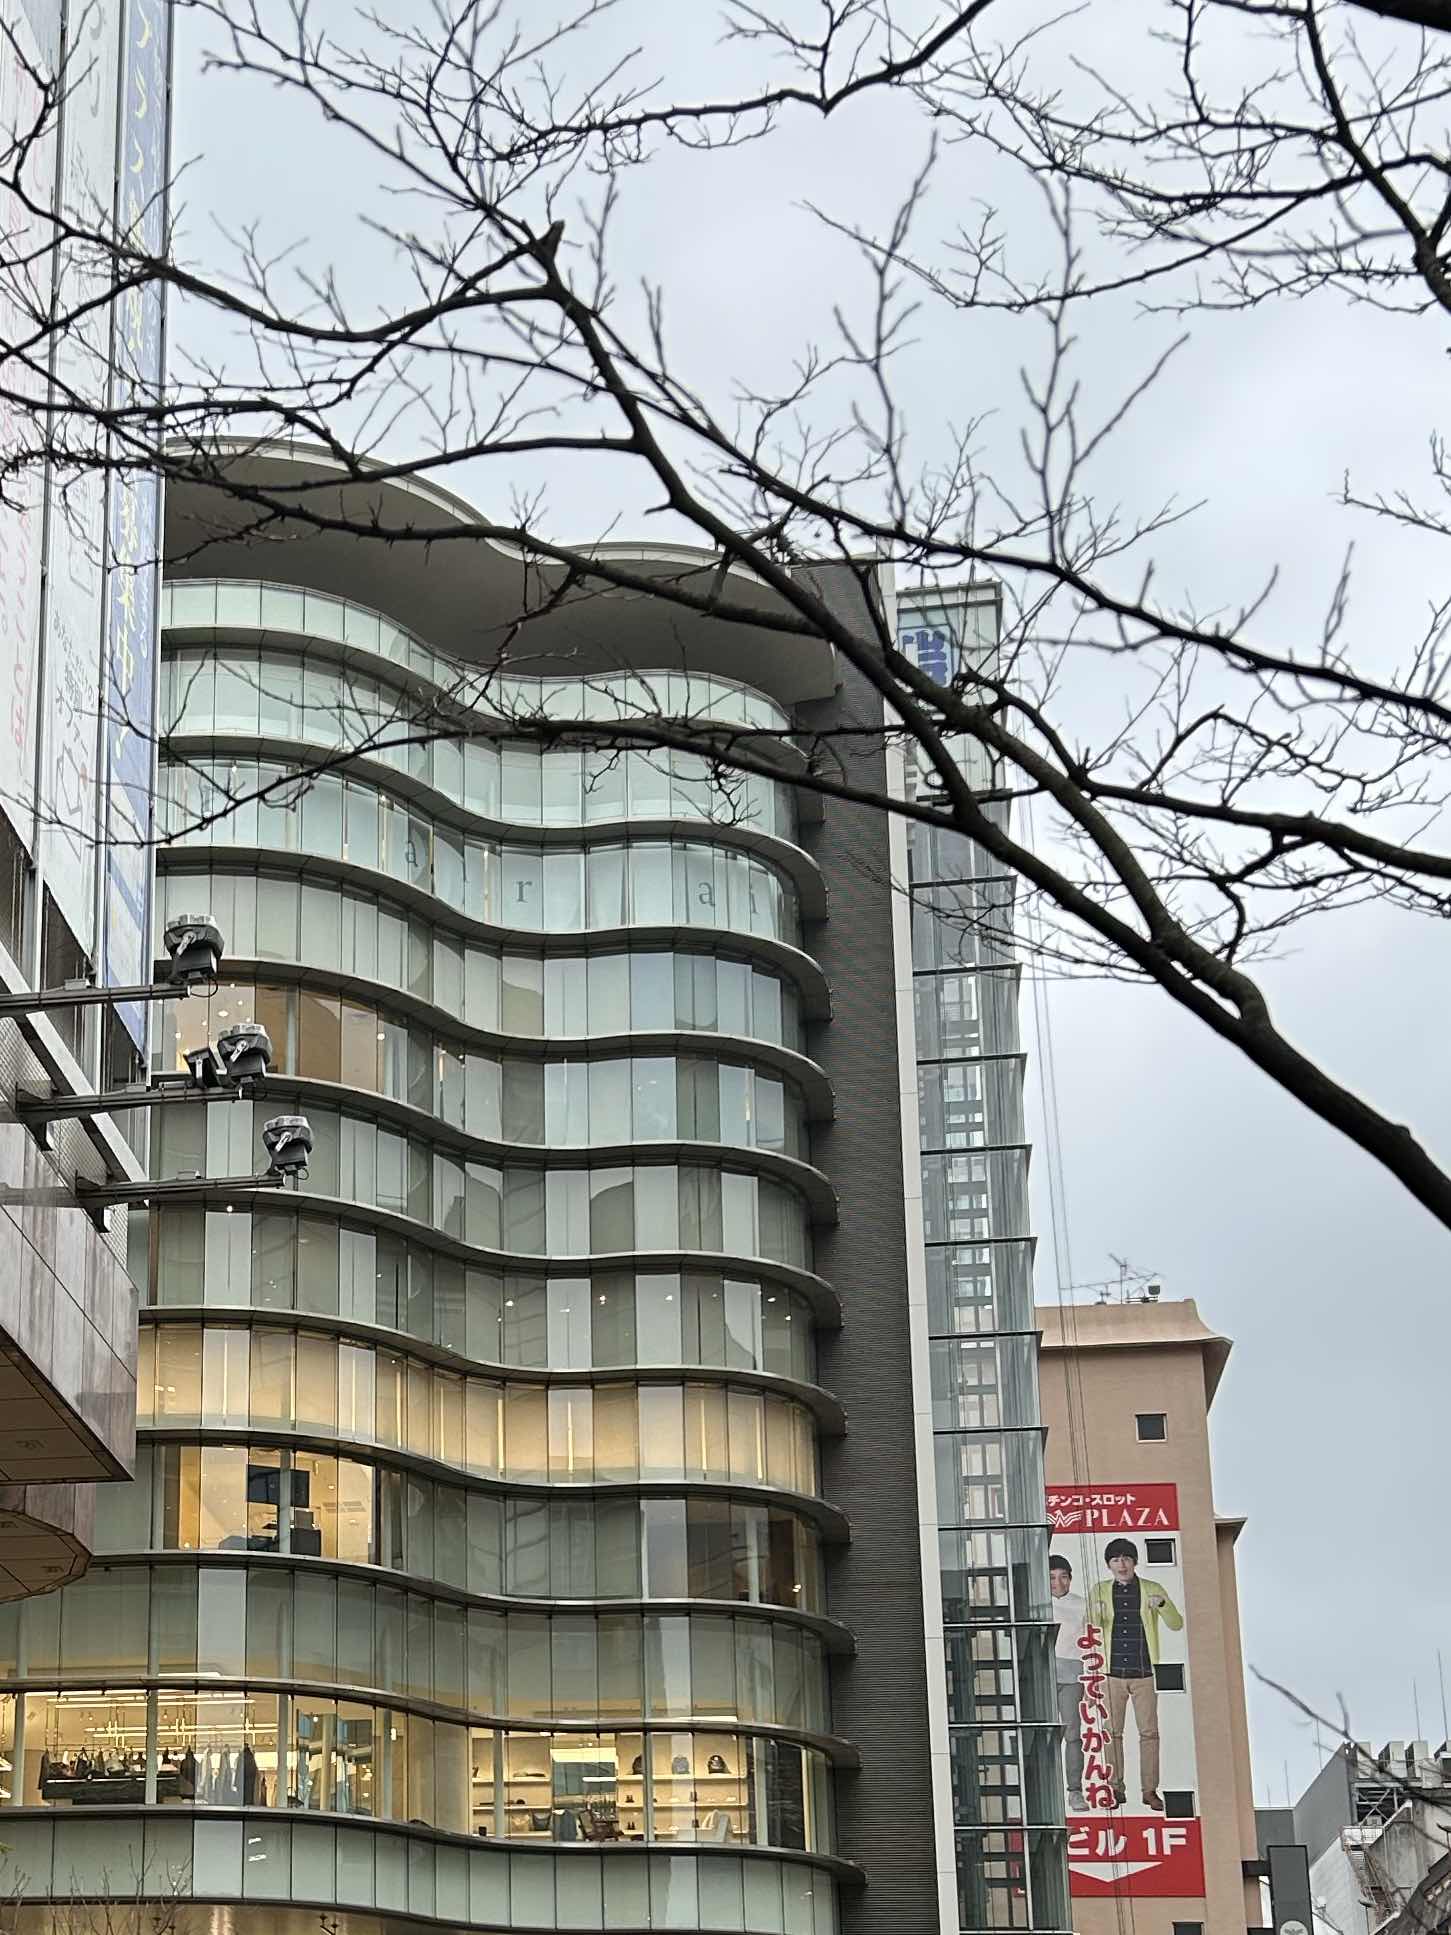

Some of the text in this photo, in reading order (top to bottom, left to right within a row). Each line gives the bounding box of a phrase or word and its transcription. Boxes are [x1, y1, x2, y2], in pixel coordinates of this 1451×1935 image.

[1047, 1493, 1136, 1507] チンコ・スロット
[1085, 1507, 1170, 1527] PLAZA
[1077, 1622, 1116, 1811] よっていかんね
[1067, 1825, 1187, 1857] ビル 1F
